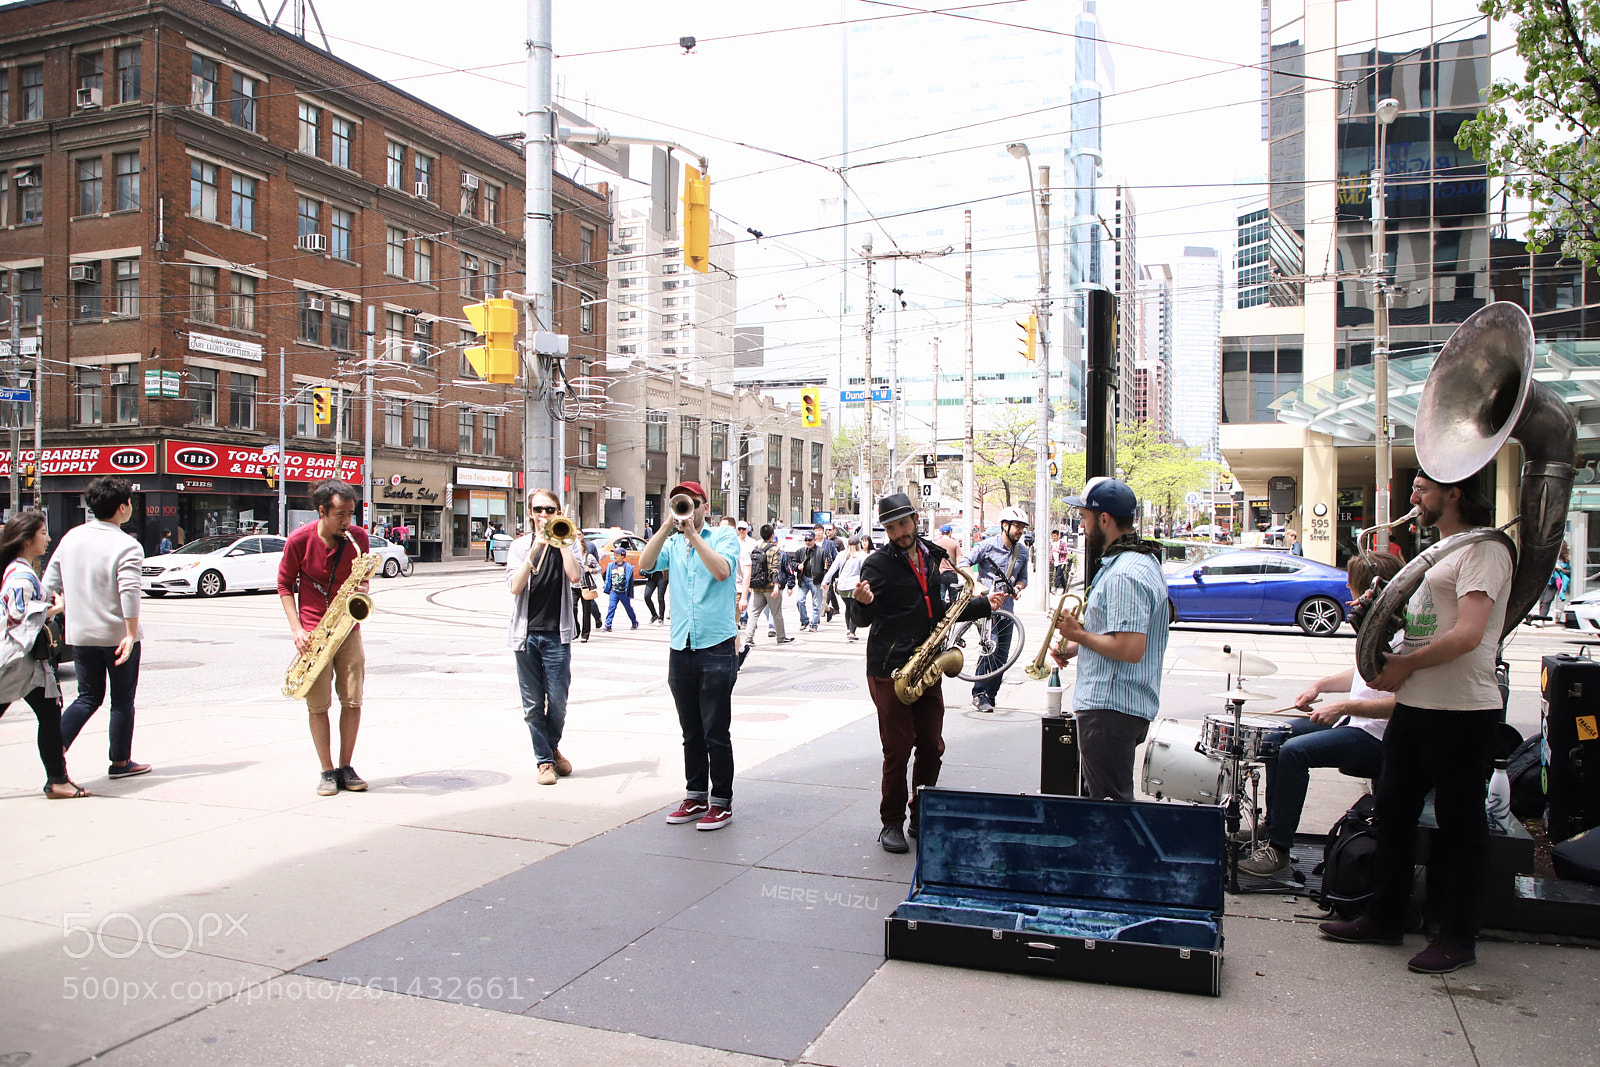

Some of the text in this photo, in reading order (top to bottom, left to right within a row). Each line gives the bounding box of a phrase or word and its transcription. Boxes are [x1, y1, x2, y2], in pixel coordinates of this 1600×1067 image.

[880, 390, 888, 398] W
[41, 449, 100, 460] BARBER
[117, 455, 140, 464] TBBS
[183, 454, 211, 464] TBBS
[228, 450, 302, 466] TORONTO
[41, 461, 97, 472] SUPPLY
[230, 464, 242, 473] &
[245, 464, 303, 477] BEUTY
[384, 486, 438, 502] Barber Shop
[1312, 519, 1329, 528] 595
